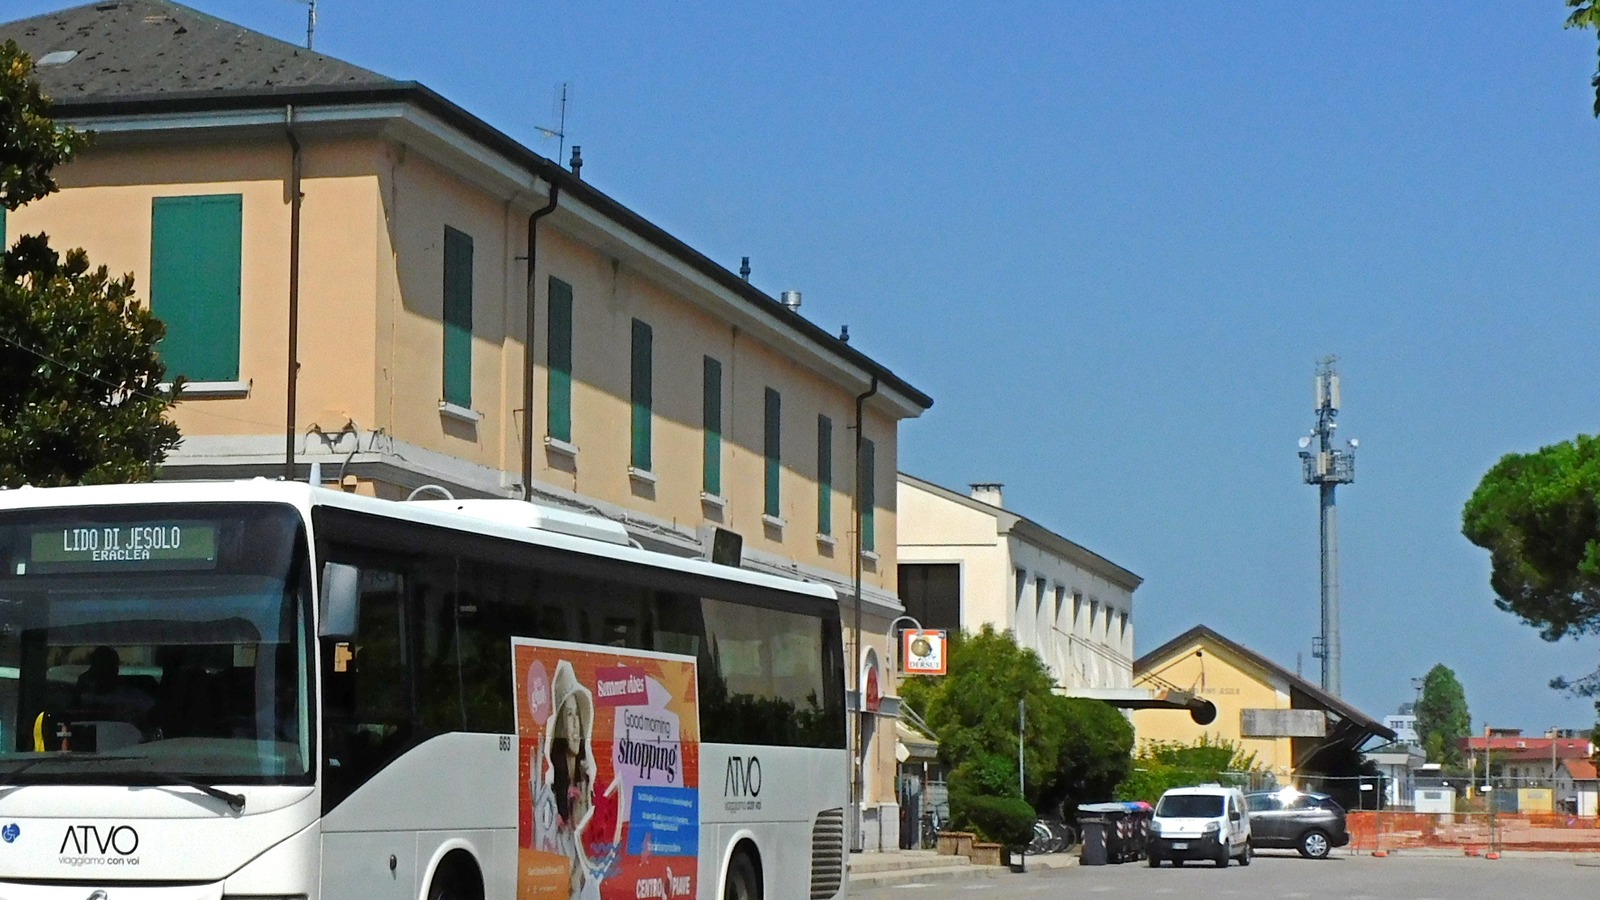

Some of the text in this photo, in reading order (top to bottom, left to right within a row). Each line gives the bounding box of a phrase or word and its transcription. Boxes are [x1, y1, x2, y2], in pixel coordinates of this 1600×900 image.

[63, 526, 181, 551] LIDO DI JESOLO
[92, 549, 150, 561] ERACLEA
[597, 680, 627, 698] Summer
[623, 708, 671, 739] Good morning
[499, 736, 511, 751] 863
[617, 730, 678, 783] shopping
[724, 756, 762, 798] ATVO
[59, 825, 139, 856] ATVO
[58, 856, 140, 867] viaggiamo con voi
